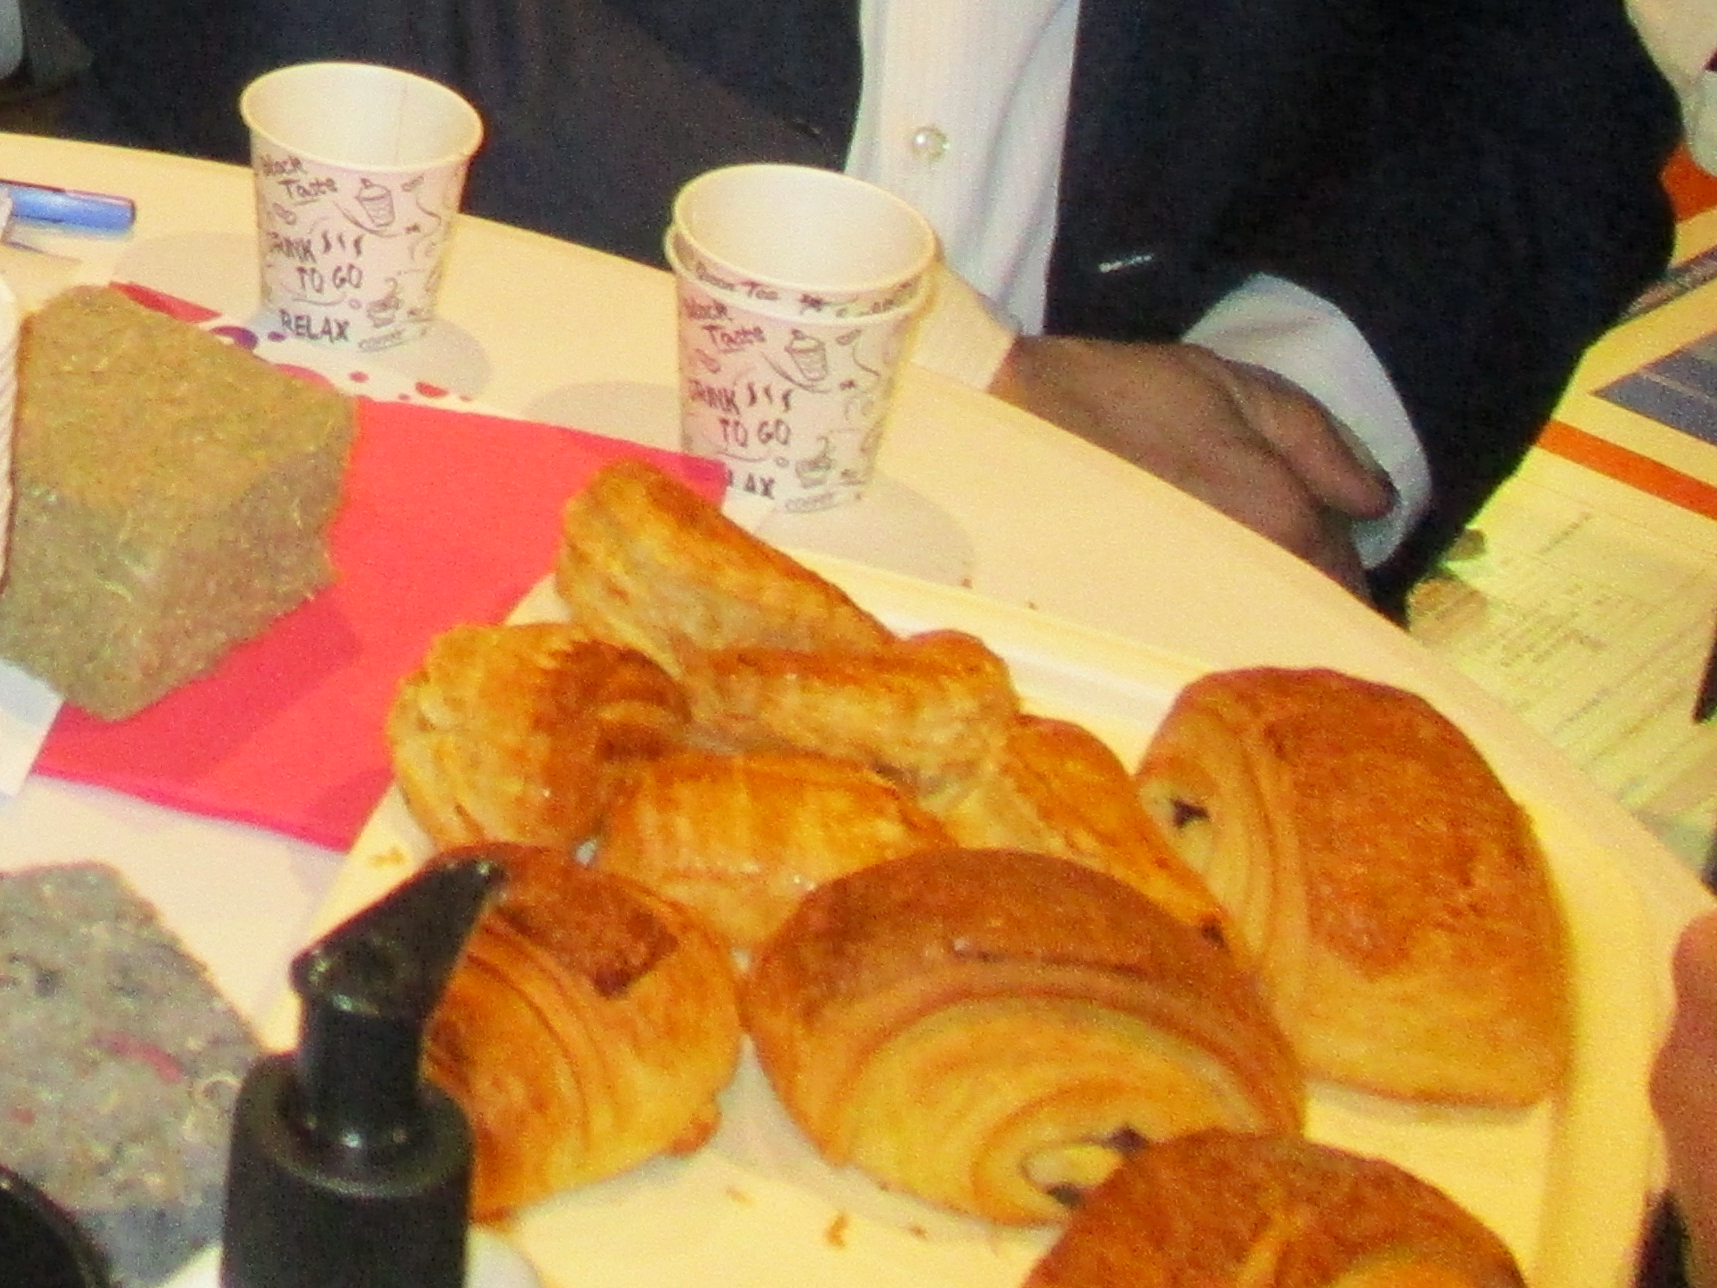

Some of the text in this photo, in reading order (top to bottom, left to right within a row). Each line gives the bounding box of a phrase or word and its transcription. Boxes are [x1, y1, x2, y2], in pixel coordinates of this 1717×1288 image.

[296, 262, 364, 295] TO GO
[278, 307, 351, 344] RELAX
[718, 418, 791, 449] TO GO
